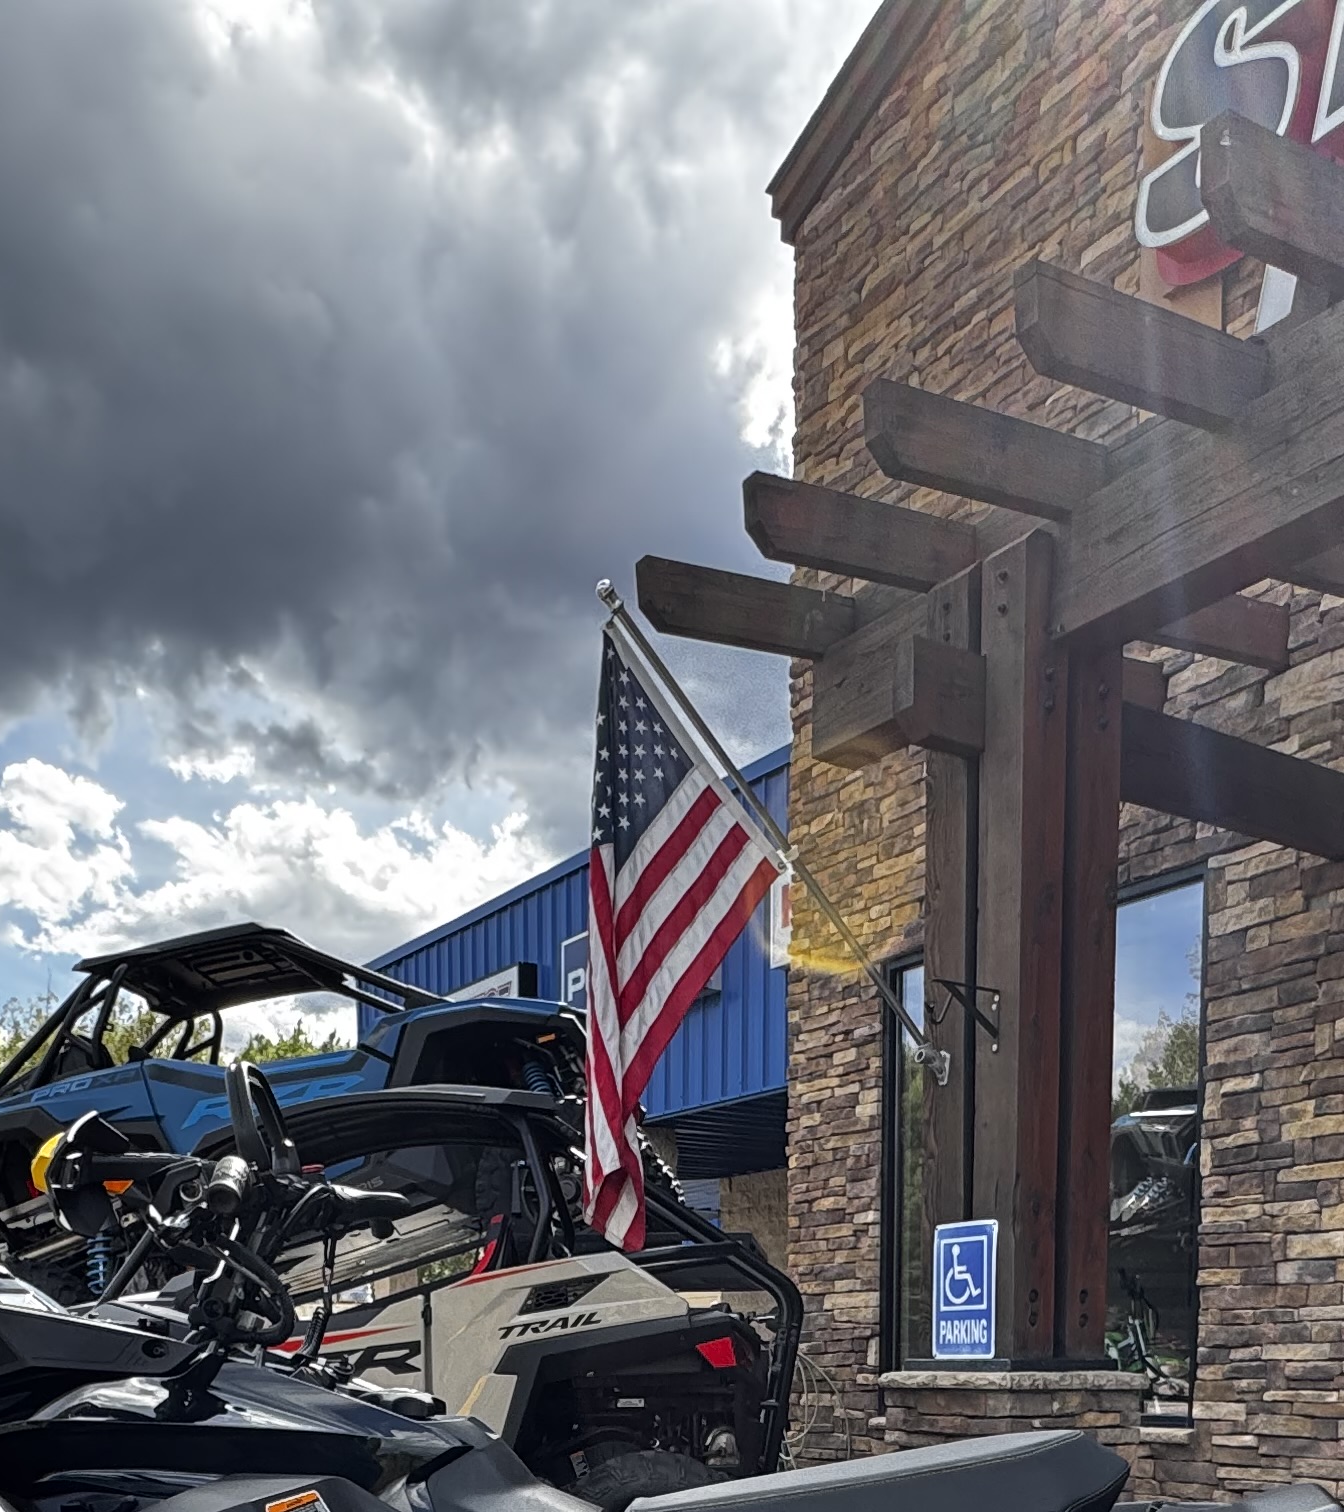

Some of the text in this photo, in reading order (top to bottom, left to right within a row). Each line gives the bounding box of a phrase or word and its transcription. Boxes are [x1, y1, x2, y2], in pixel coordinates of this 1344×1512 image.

[31, 1078, 93, 1102] PRO
[497, 1311, 603, 1340] TRAIL
[939, 1318, 988, 1345] PARKING
